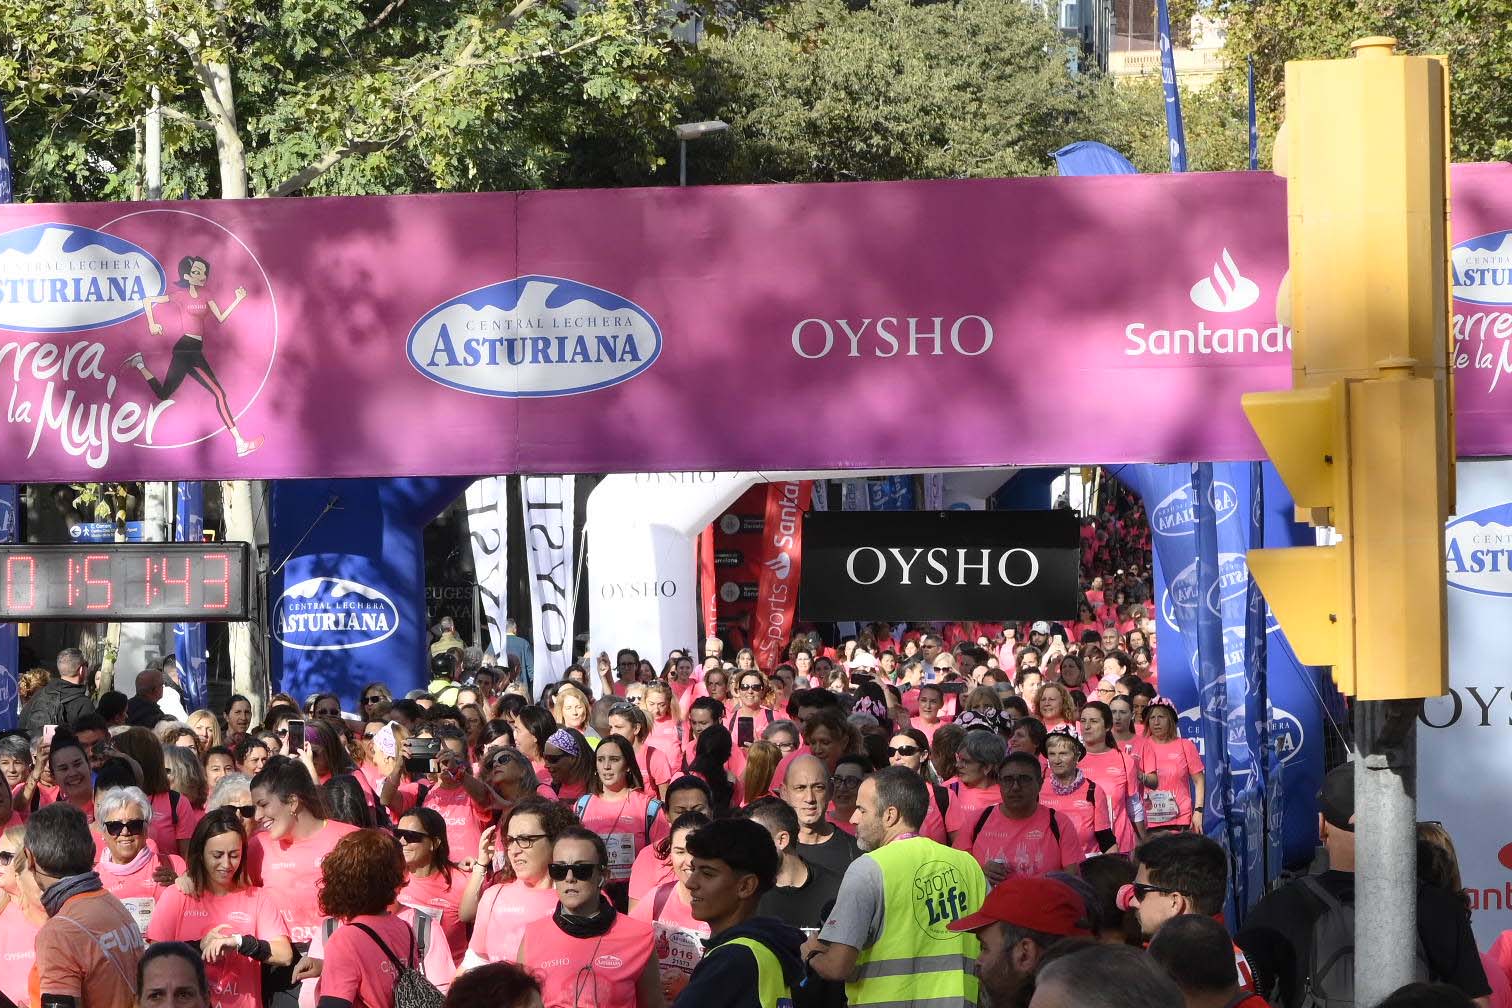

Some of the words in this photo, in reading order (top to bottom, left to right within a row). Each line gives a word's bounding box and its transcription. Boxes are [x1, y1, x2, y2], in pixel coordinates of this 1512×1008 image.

[69, 259, 141, 271] LECHERA
[465, 318, 544, 331] CENTRAL
[552, 316, 633, 330] LECHERA
[791, 315, 994, 359] OYSHO
[426, 322, 642, 367] ASTURIANA
[1475, 341, 1493, 369] la
[7, 383, 32, 424] la
[26, 375, 176, 469] Mujer
[845, 546, 1039, 587] OYSHO
[7, 555, 231, 611] 01:51:43
[601, 581, 676, 598] OYSHO
[277, 607, 389, 634] ASTURIANA
[289, 602, 332, 611] CENTRAL
[336, 602, 384, 610] LECHERA
[761, 583, 787, 652] Sports
[914, 866, 958, 902] Sport
[925, 886, 968, 926] Life
[541, 957, 569, 968] OYSHO
[672, 949, 693, 960] 016
